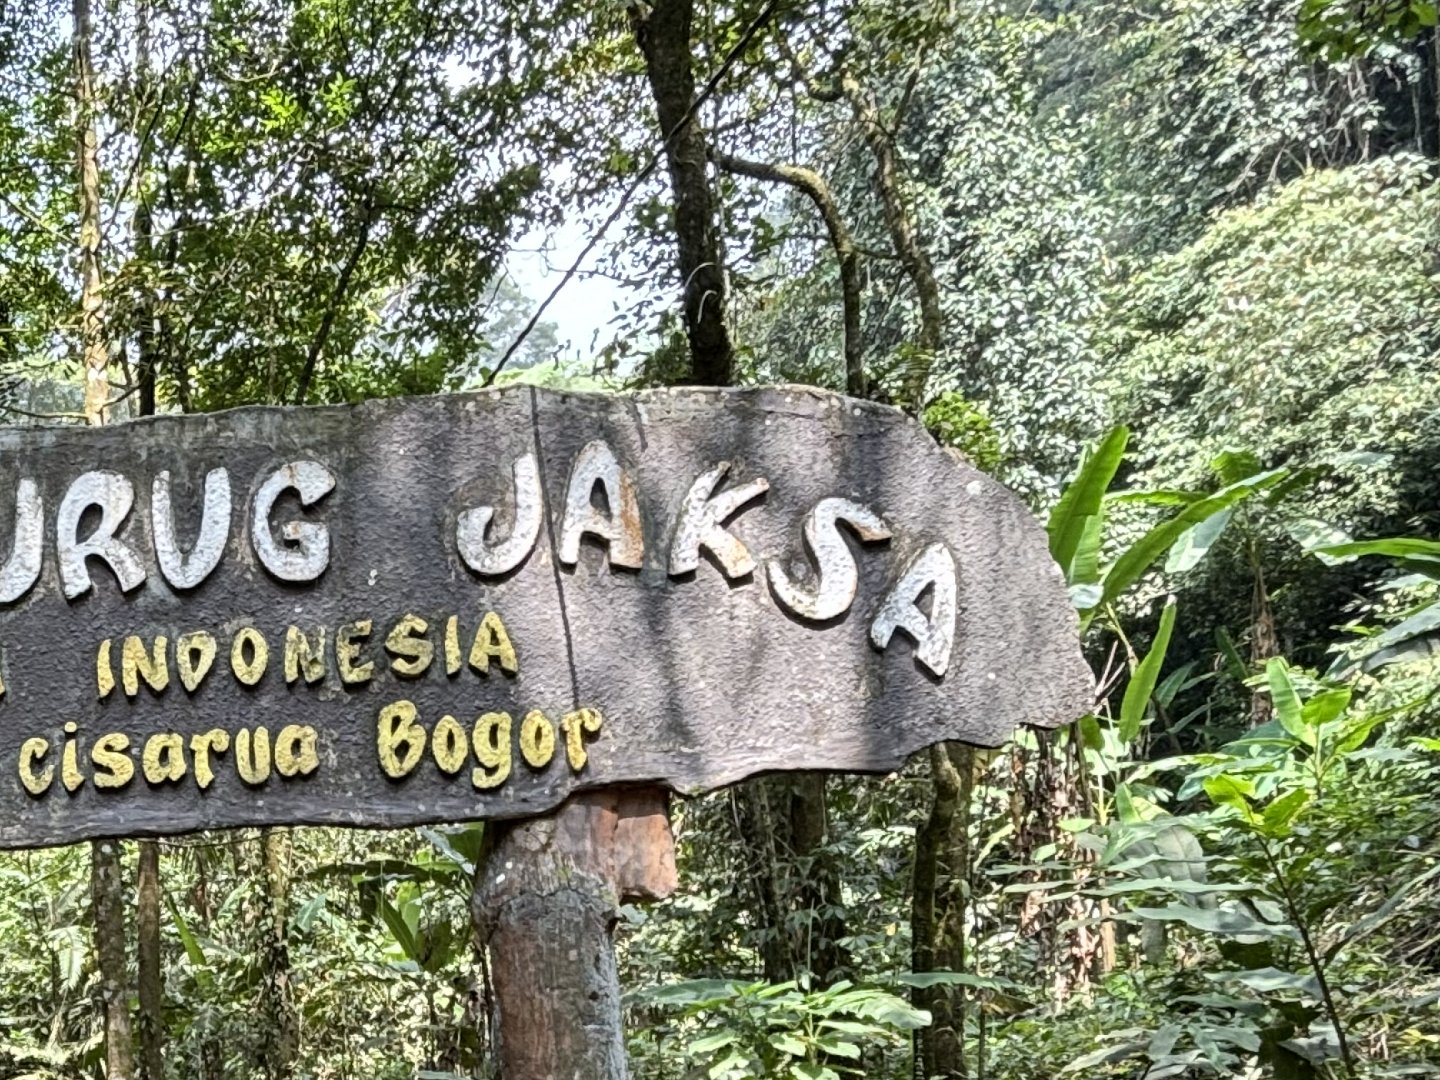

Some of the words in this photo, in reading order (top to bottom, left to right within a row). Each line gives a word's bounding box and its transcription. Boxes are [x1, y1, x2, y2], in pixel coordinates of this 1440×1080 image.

[457, 440, 957, 678] JAKSA
[97, 611, 518, 699] INDONESIA
[377, 699, 602, 790] Bogor
